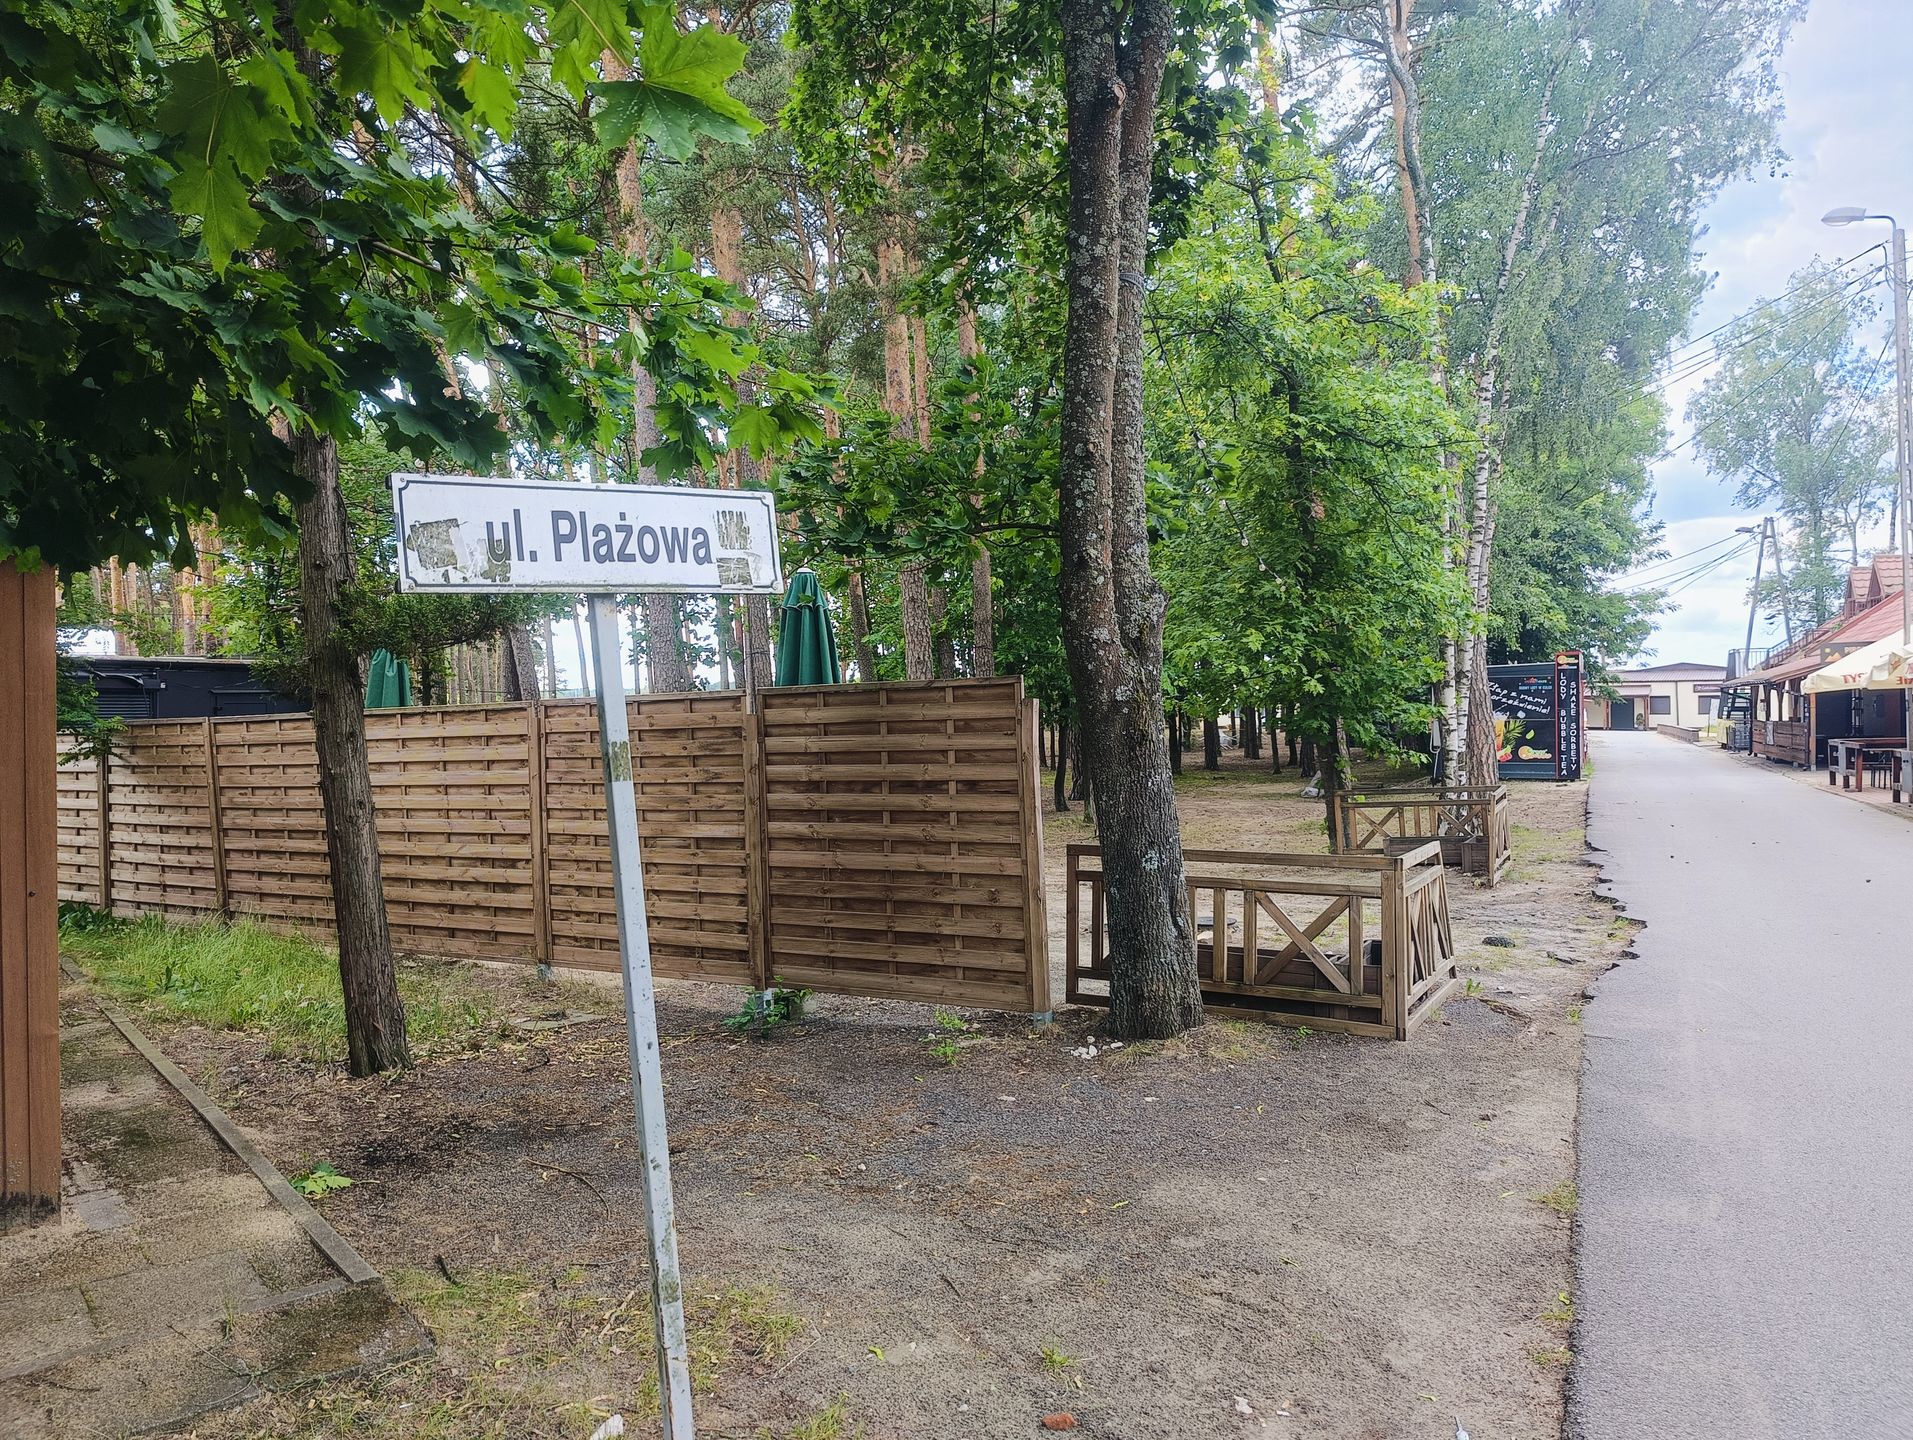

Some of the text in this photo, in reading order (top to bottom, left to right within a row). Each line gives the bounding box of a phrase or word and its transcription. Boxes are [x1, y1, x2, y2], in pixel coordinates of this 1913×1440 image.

[485, 508, 714, 565] ul. Plażowa
[1519, 694, 1548, 705] nami
[1569, 681, 1577, 771] SHAKE SORBETY
